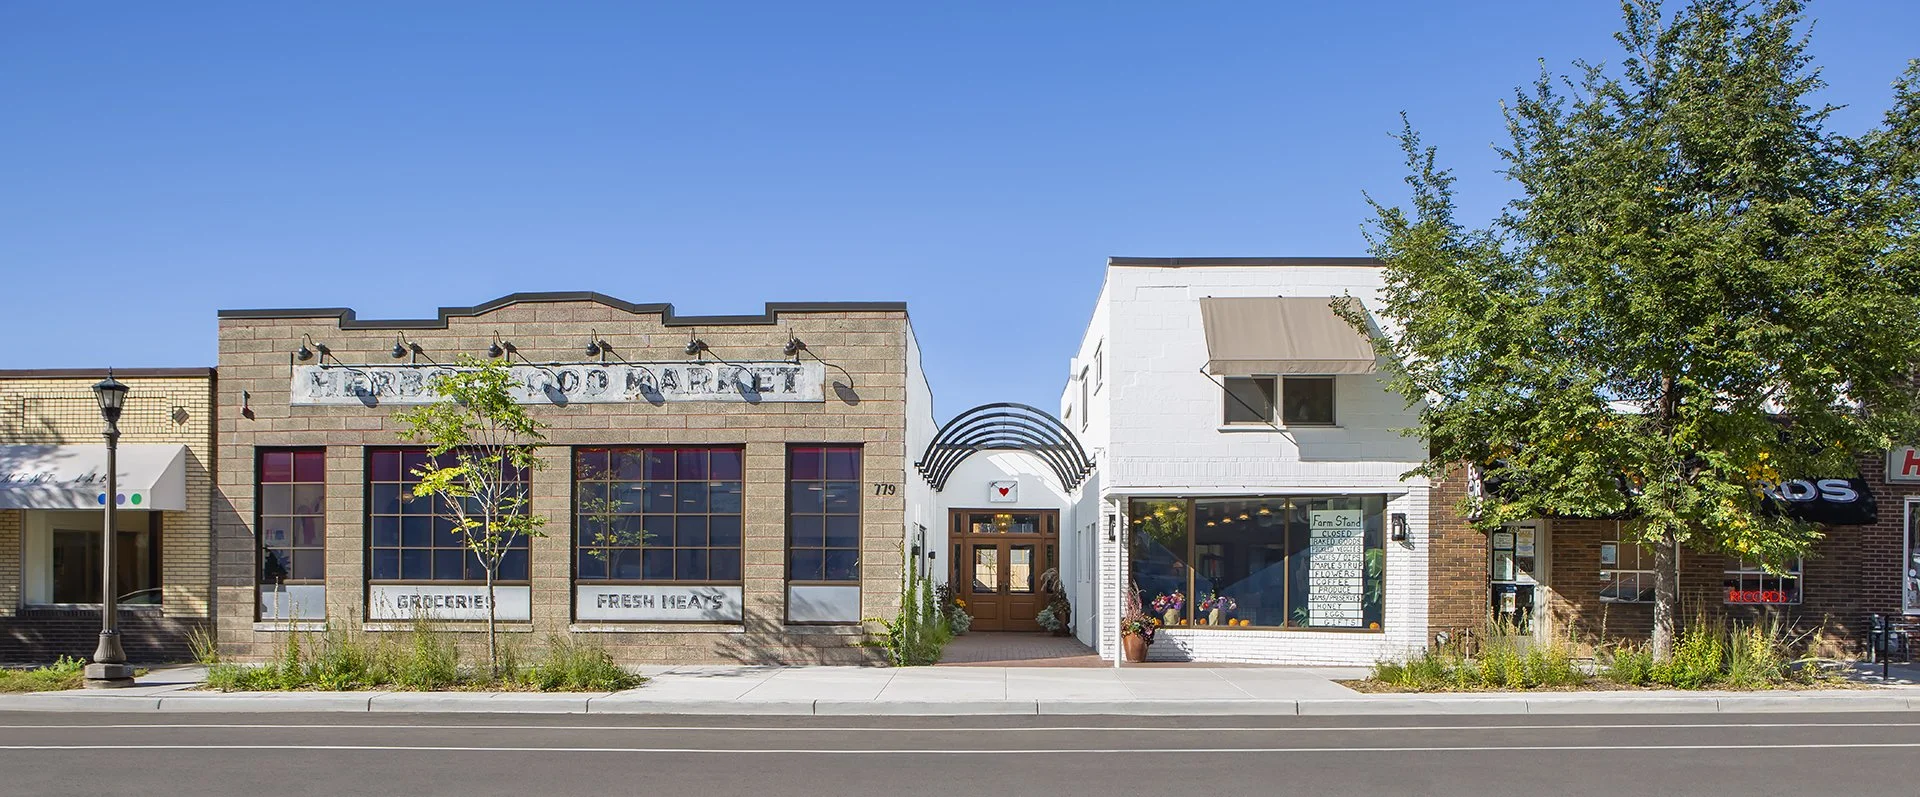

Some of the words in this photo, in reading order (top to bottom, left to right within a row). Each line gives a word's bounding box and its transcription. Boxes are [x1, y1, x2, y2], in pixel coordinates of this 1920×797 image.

[309, 369, 455, 398] HERB
[623, 366, 805, 396] MARKET
[874, 483, 896, 496] 779
[1313, 514, 1334, 527] Farm
[1335, 515, 1361, 527] Stand
[1321, 530, 1352, 538] CLOSED
[1313, 538, 1335, 546] BAKED
[1338, 538, 1361, 546] GOODS
[1315, 570, 1355, 578] FLOWERS
[1316, 578, 1349, 586] COFFEE
[1318, 586, 1351, 594] PRODUCE
[1729, 590, 1787, 603] RECORDS
[597, 594, 655, 609] FRESH
[662, 594, 723, 609] MEATS
[1317, 602, 1342, 610] HONEY
